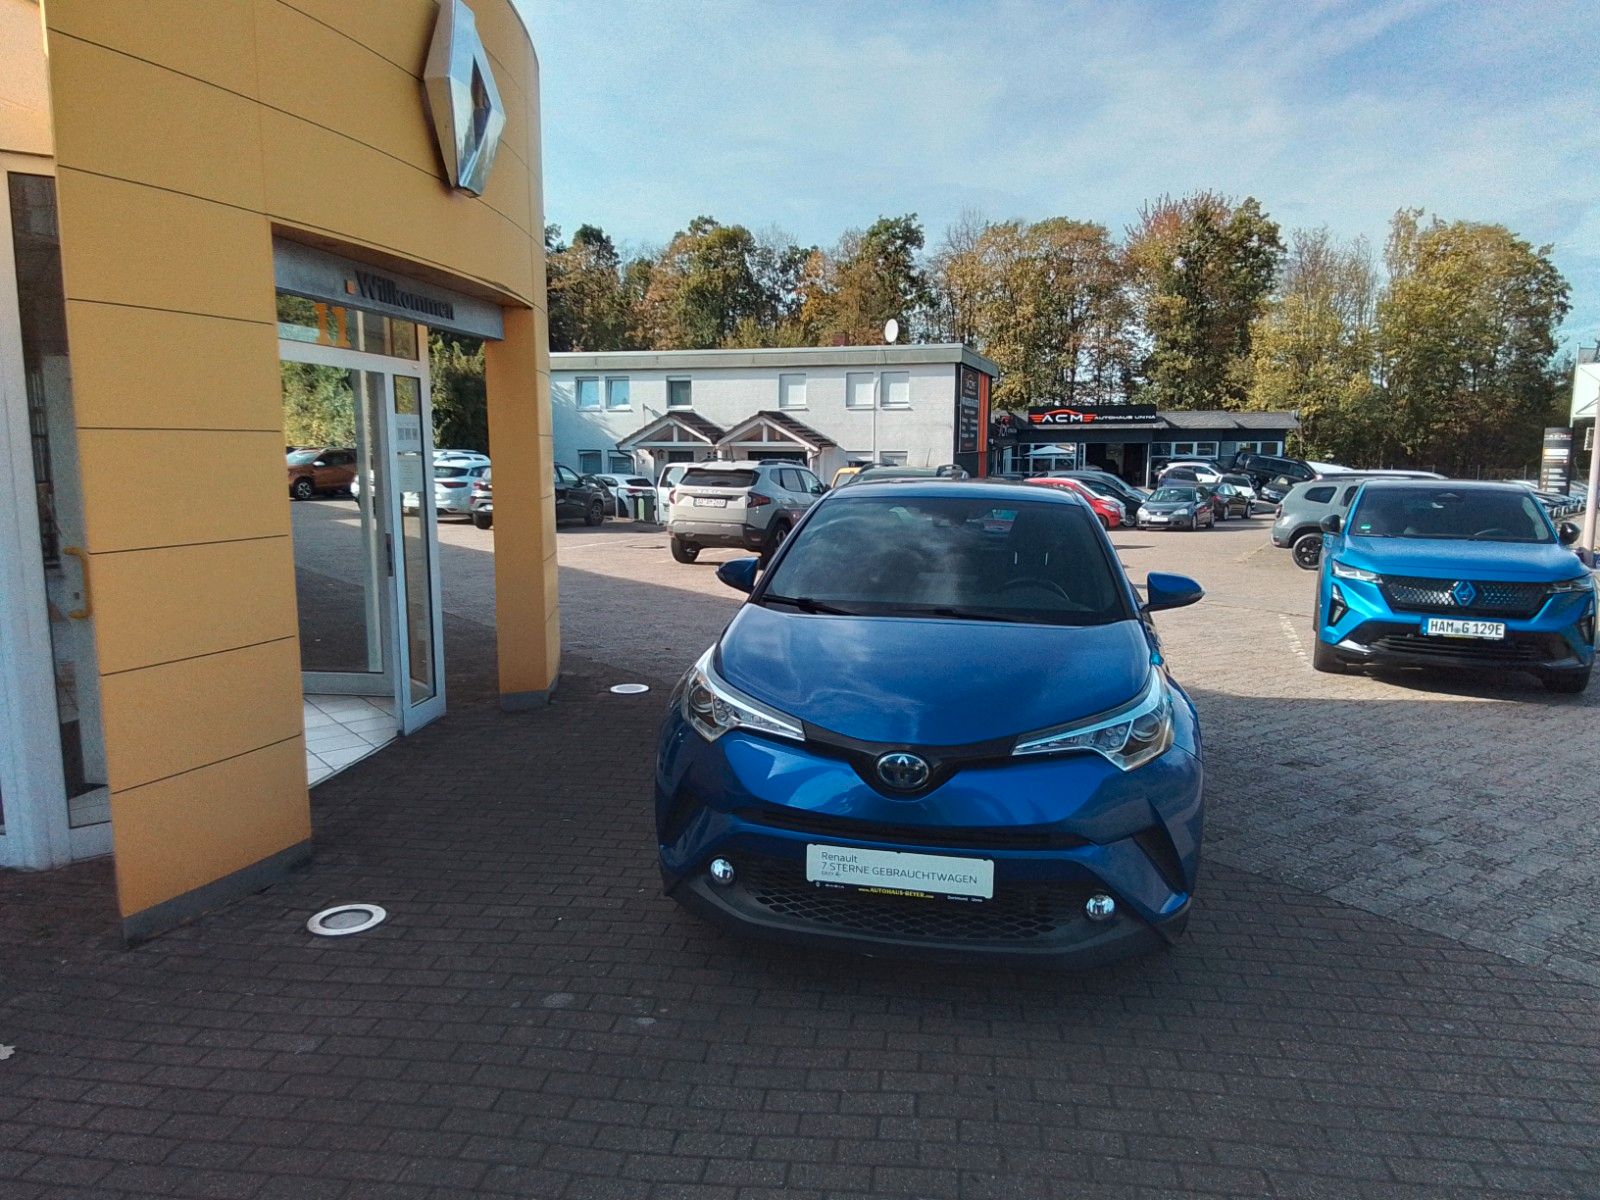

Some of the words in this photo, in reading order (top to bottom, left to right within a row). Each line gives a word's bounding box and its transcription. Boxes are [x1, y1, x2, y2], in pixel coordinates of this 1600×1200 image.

[355, 271, 455, 321] Willkommen
[1042, 414, 1083, 423] ACM
[1430, 620, 1454, 633] HAM
[1461, 622, 1470, 634] G
[1472, 623, 1503, 636] 129E
[821, 851, 858, 863] Renault
[829, 863, 870, 875] STERNE
[871, 867, 978, 884] GEBRAUCHTWAGEN
